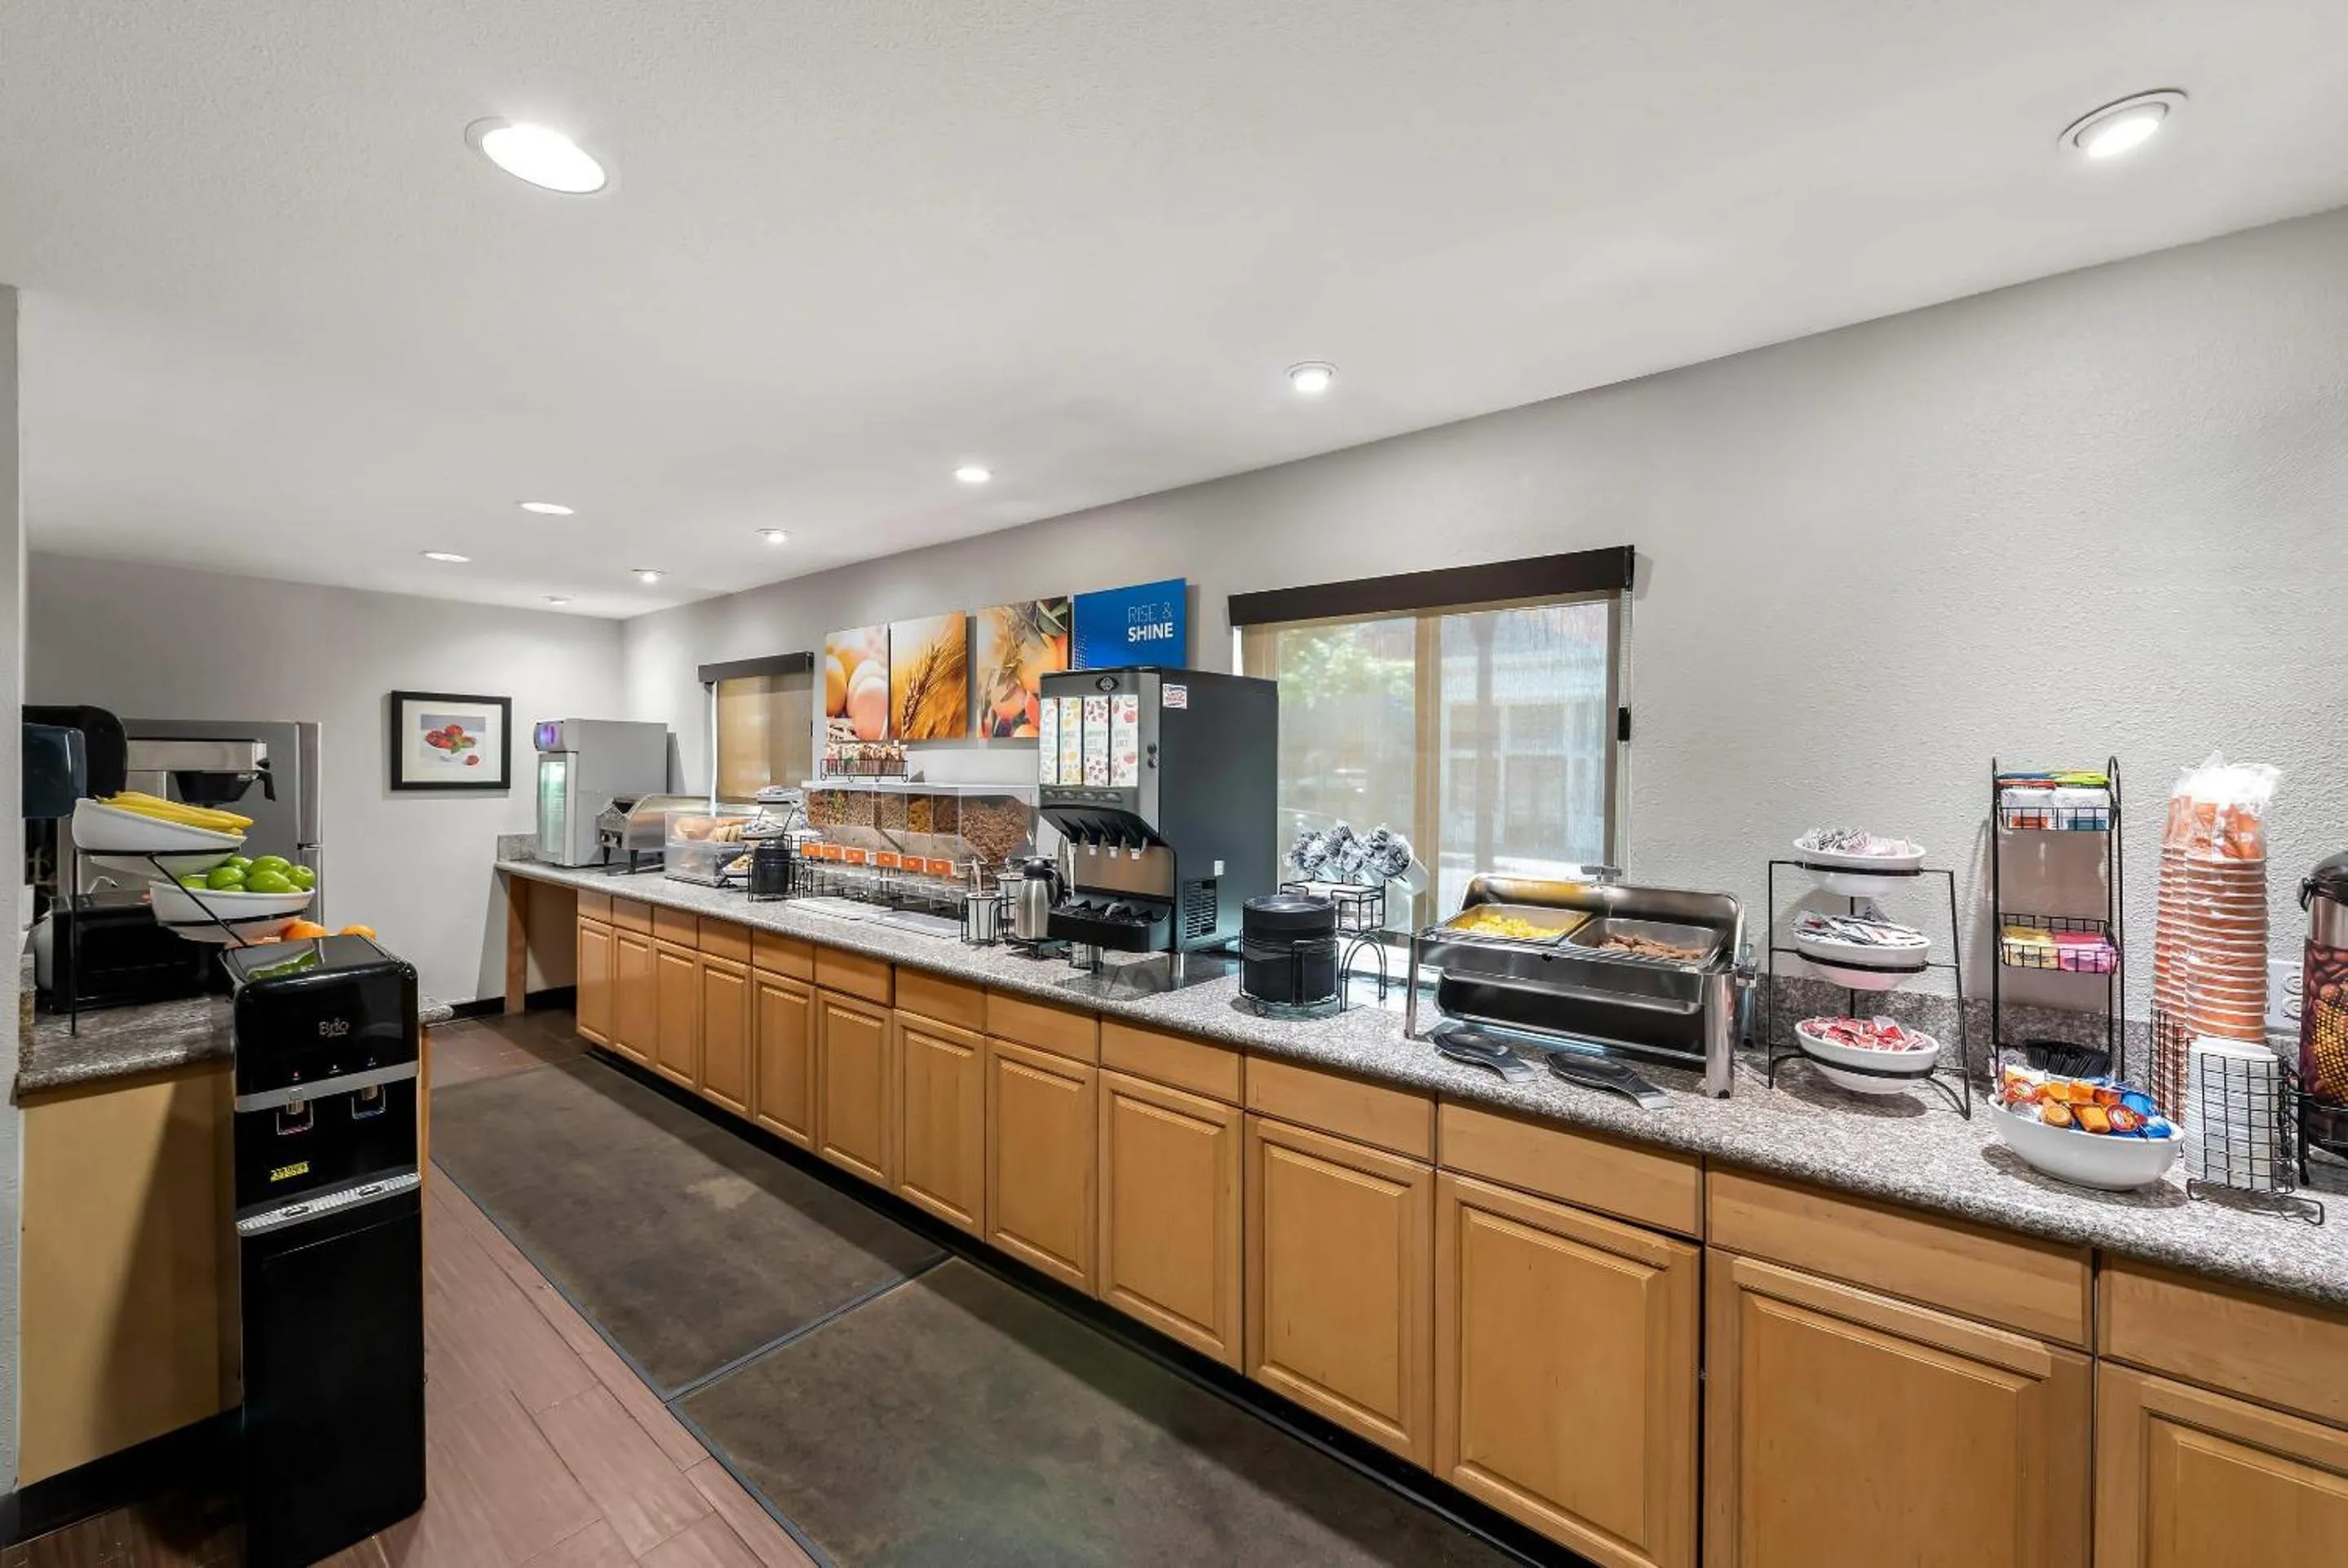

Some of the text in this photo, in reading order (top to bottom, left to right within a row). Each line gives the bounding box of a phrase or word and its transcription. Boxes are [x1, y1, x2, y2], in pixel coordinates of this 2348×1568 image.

[1128, 600, 1174, 624] RISE &
[1128, 622, 1174, 643] SHINE
